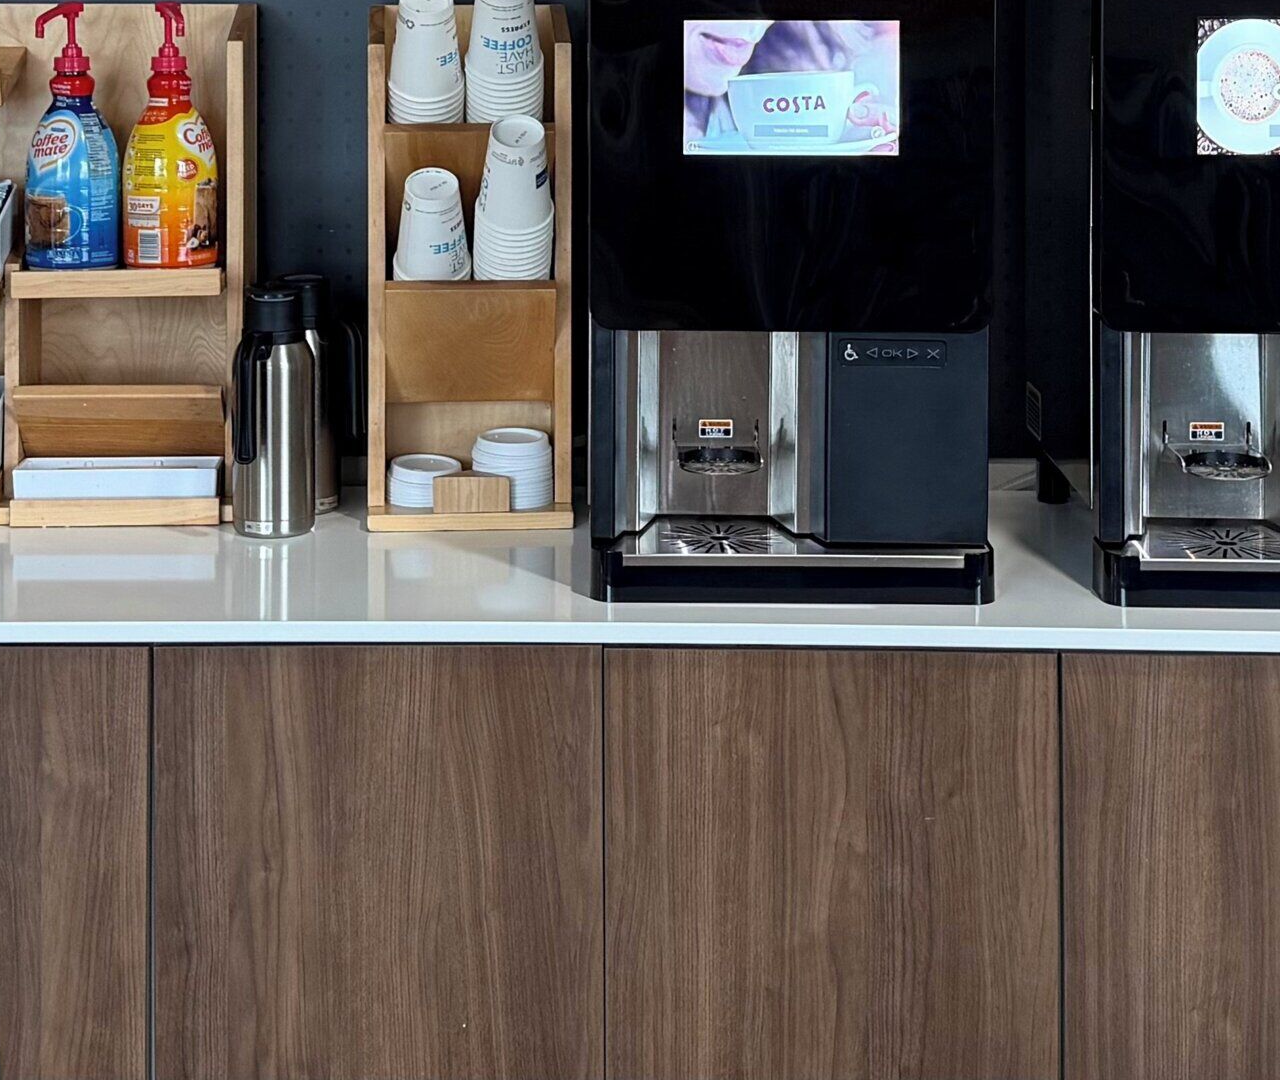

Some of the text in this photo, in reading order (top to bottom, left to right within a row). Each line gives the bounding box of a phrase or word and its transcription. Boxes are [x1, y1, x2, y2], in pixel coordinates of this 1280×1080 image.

[480, 33, 533, 51] COFFEE.
[762, 95, 826, 114] COSTA
[32, 130, 69, 148] Coffee
[34, 143, 68, 159] mate
[881, 348, 903, 358] OK
